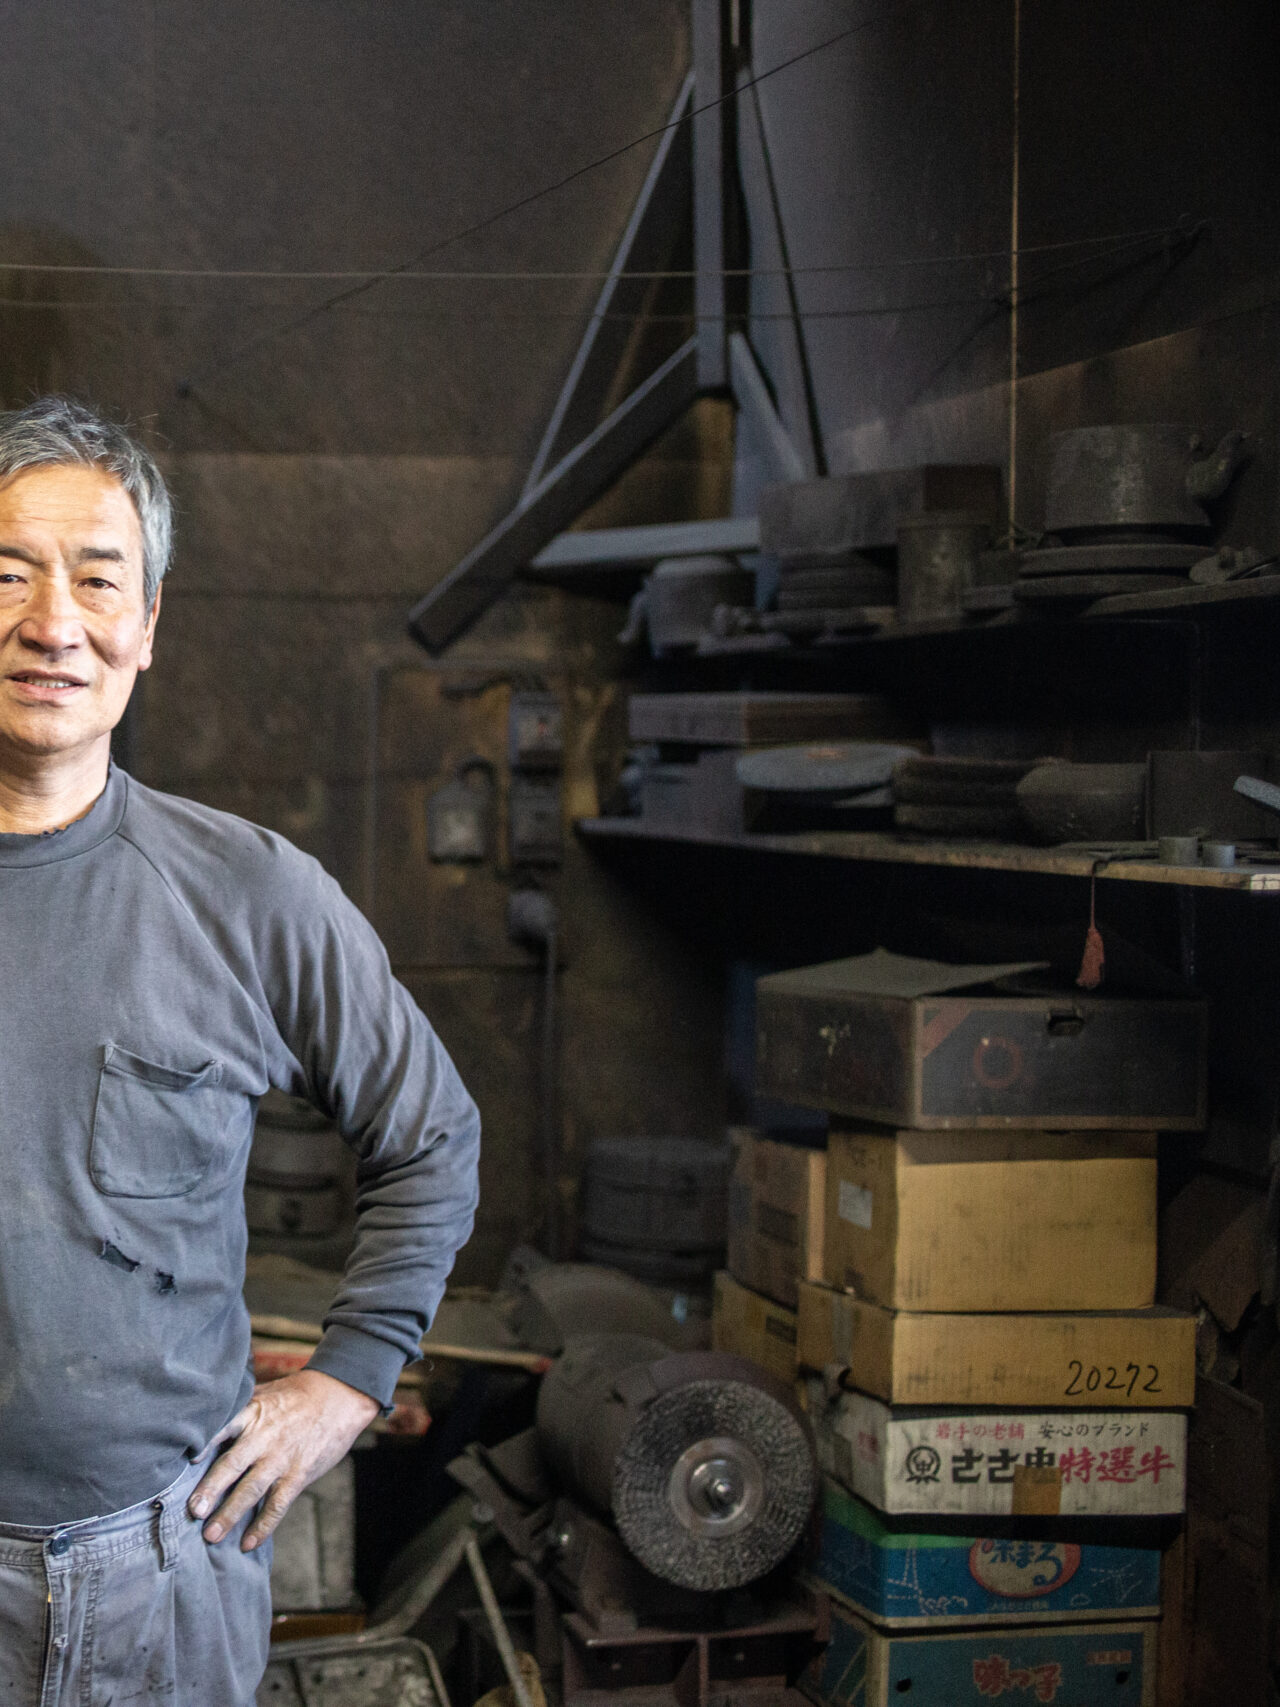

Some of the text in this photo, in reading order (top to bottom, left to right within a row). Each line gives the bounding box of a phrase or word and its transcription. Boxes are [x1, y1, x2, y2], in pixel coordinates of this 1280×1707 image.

[1064, 1360, 1163, 1397] 20272
[1038, 1421, 1150, 1441] 安心のブランド
